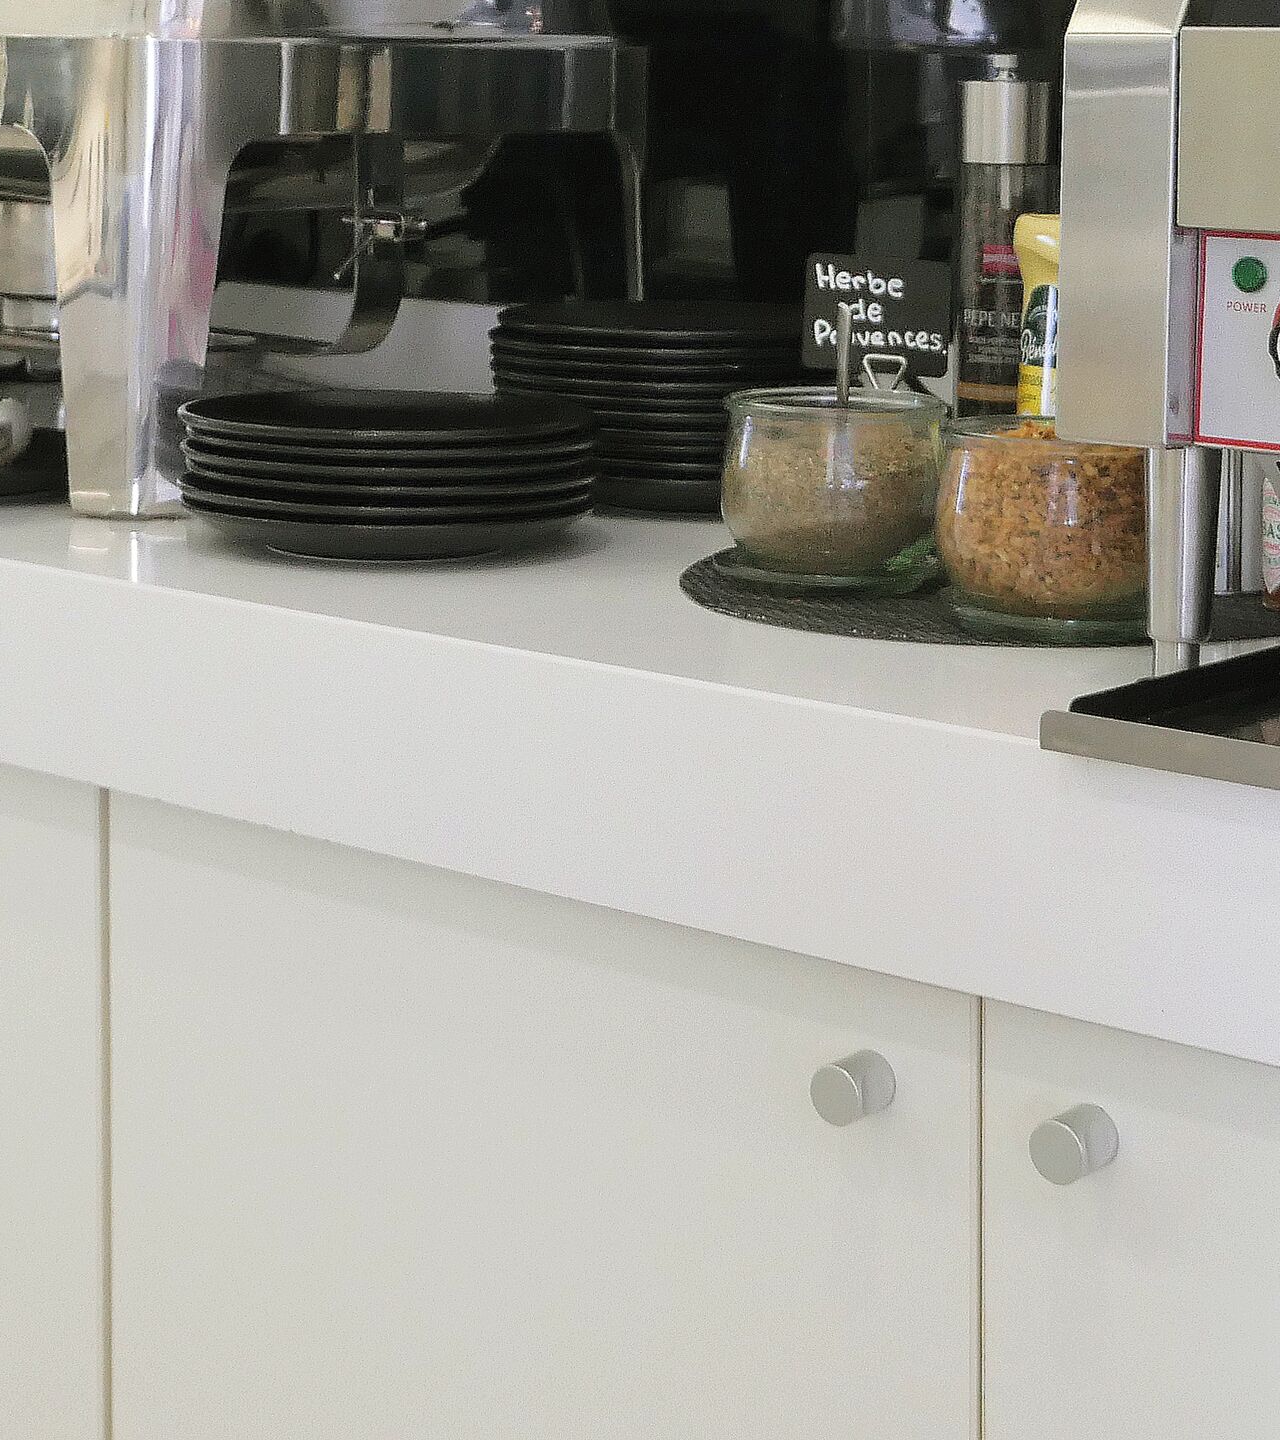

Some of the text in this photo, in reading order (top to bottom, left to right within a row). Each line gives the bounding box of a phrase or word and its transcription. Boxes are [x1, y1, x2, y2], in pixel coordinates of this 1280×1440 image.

[815, 263, 904, 298] Herbe
[849, 298, 882, 323] de
[1226, 301, 1267, 313] POWER
[813, 318, 947, 354] Pvences.
